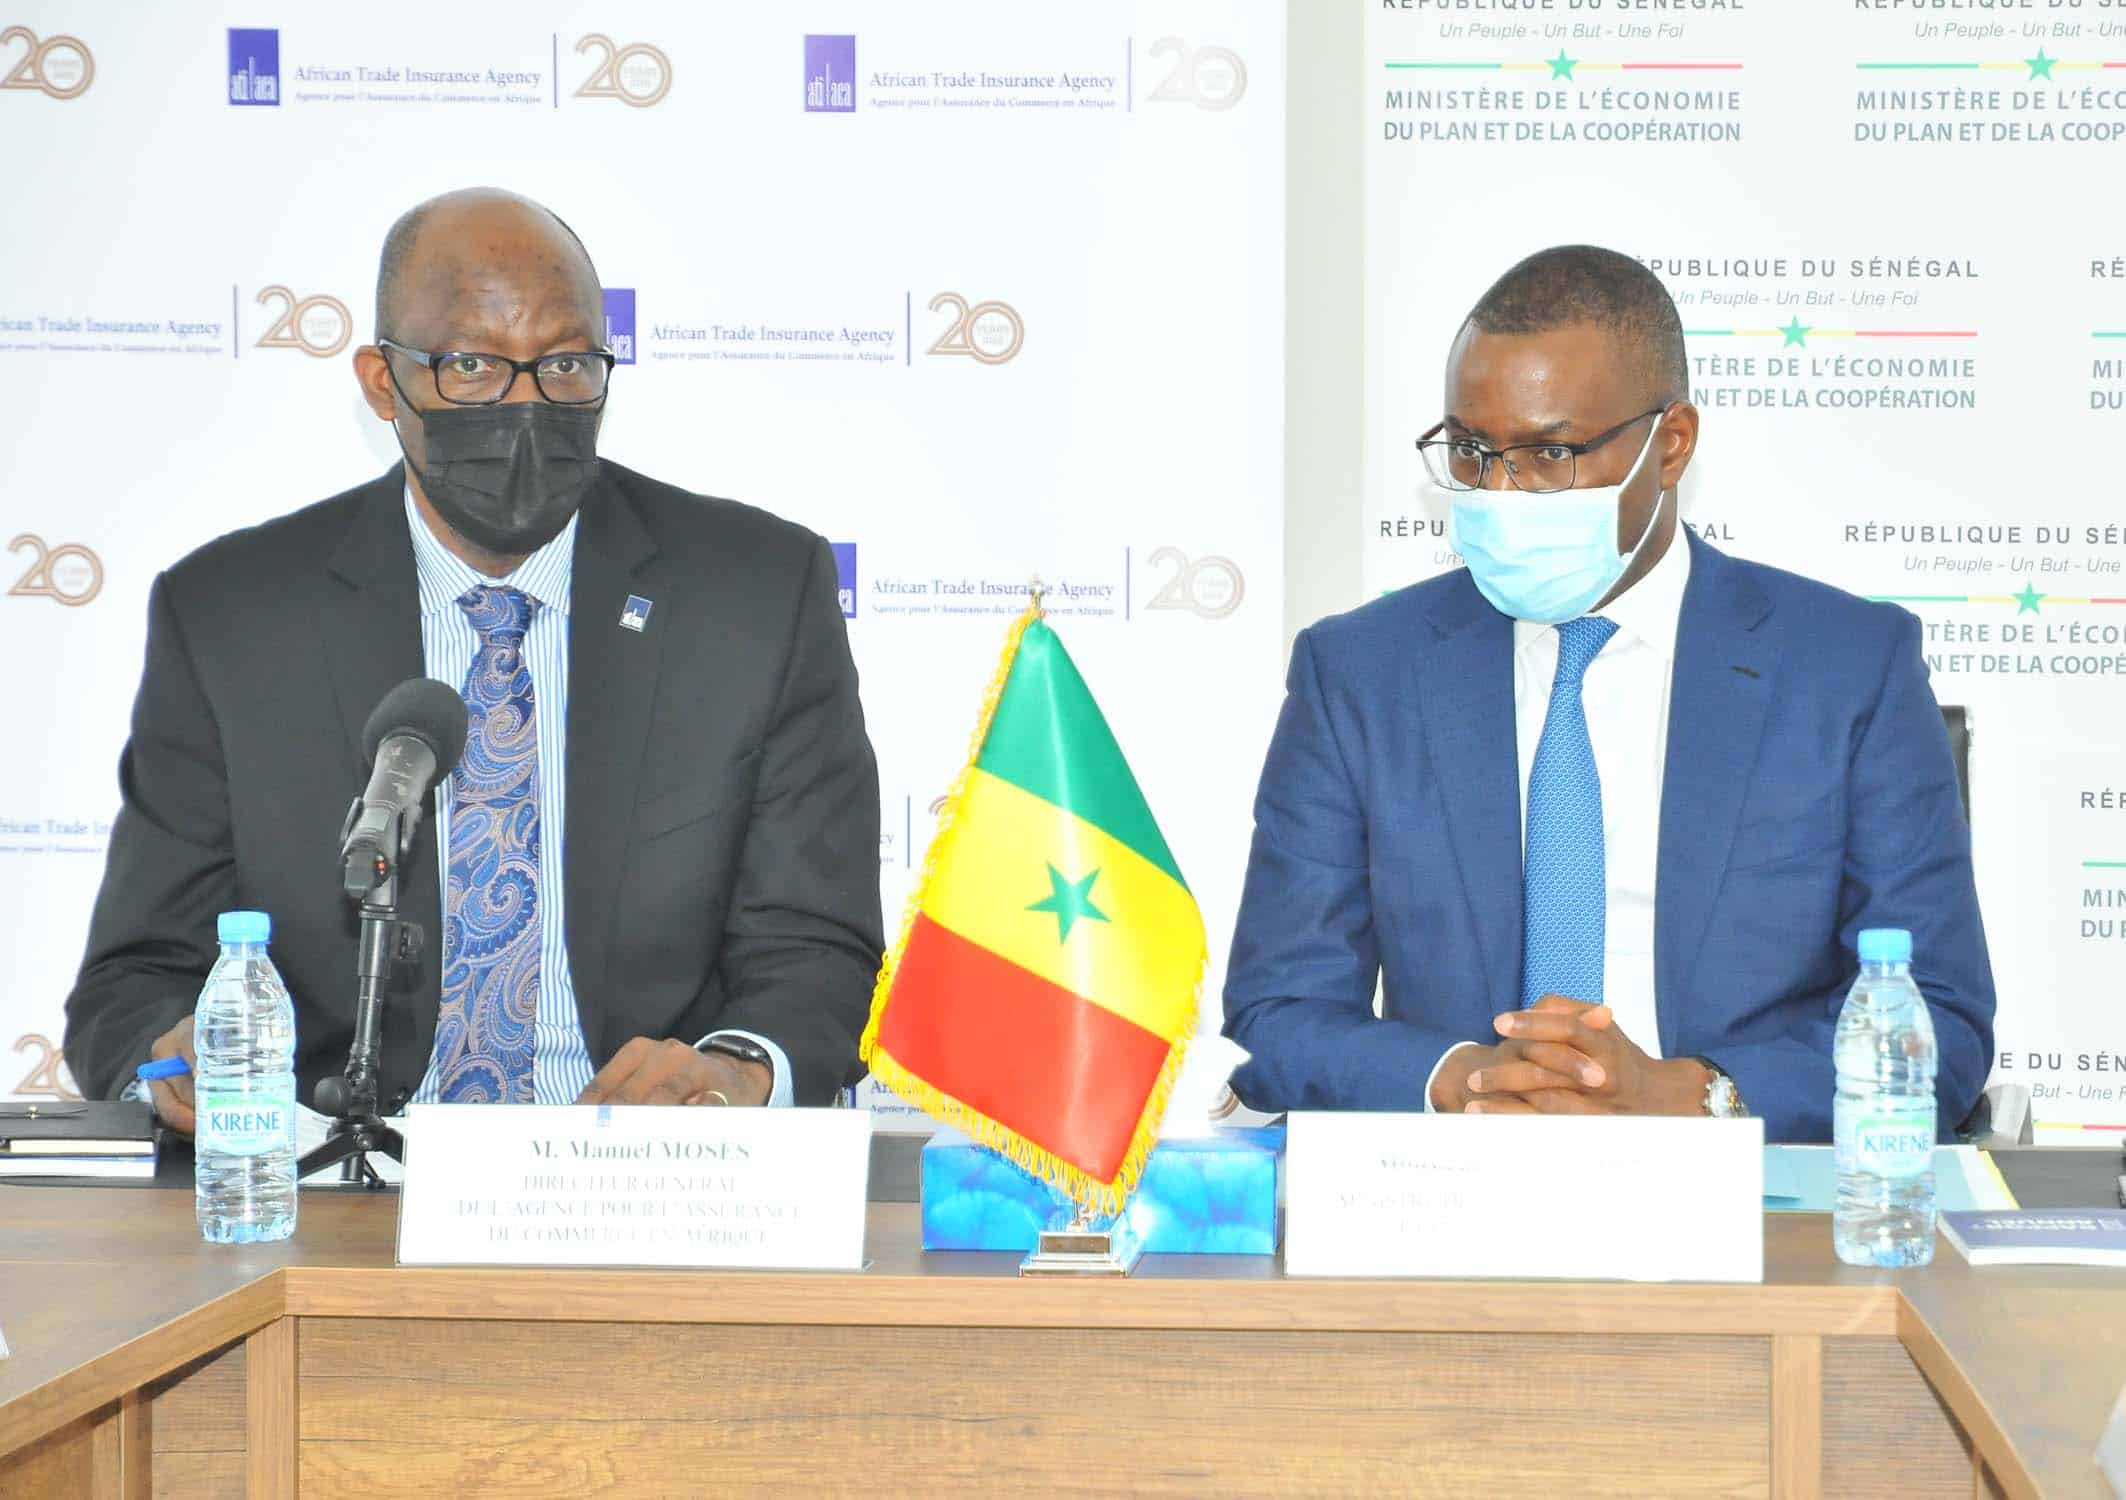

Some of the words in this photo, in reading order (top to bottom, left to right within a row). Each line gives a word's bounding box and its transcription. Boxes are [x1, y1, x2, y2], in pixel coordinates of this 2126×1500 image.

[1440, 23, 1462, 38] Un
[1468, 23, 1526, 40] Peuple
[1544, 23, 1567, 38] Un
[1573, 23, 1601, 38] But
[1618, 23, 1652, 38] Une
[1658, 23, 1686, 38] Foi
[1914, 22, 1938, 38] Un
[1944, 22, 2004, 40] Peuple
[2022, 22, 2047, 37] Un
[2052, 22, 2081, 37] But
[296, 65, 352, 81] African
[355, 66, 401, 82] Trade
[405, 66, 480, 82] Insurance
[485, 67, 542, 88] Agency
[574, 33, 672, 108] 20
[1145, 37, 1248, 112] 20
[870, 72, 927, 88] African
[930, 72, 976, 88] Trade
[980, 72, 1055, 88] Insurance
[1061, 72, 1114, 92] Agency
[1385, 88, 1524, 110] MINISTÈRE
[1535, 91, 1568, 110] DE
[1579, 88, 1740, 110] L'ÉCONOMIE
[1857, 87, 2000, 110] MINISTÈRE
[2012, 91, 2046, 110] DE
[1384, 122, 1413, 141] DU
[1420, 122, 1477, 141] PLAN
[1484, 122, 1510, 141] ET
[1515, 122, 1544, 141] DE
[1550, 122, 1577, 141] LA
[1583, 118, 1740, 141] COOPÉRATION
[1855, 122, 1886, 141] DU
[1894, 122, 1952, 141] PLAN
[1959, 122, 1985, 141] ET
[1992, 122, 2021, 141] DE
[2027, 122, 2055, 141] LA
[2062, 122, 2126, 141] COOP
[1642, 257, 1787, 277] PUBLIQUE
[1801, 259, 1835, 277] DU
[1850, 256, 1978, 278] SÉNÉGAL
[1700, 290, 1758, 308] Peuple
[1776, 290, 1800, 305] Un
[1806, 290, 1834, 305] But
[1852, 290, 1886, 306] Une
[1891, 290, 1920, 305] Foi
[255, 285, 353, 359] 20
[926, 291, 1024, 365] 20
[650, 325, 706, 341] African
[711, 325, 754, 341] Trade
[760, 326, 835, 342] Insurance
[840, 327, 895, 346] Agency
[1768, 358, 1800, 376] DE
[1812, 355, 1975, 377] L'ÉCONOMIE
[1716, 389, 1742, 407] ET
[1747, 389, 1776, 407] DE
[1782, 389, 1809, 407] LA
[1815, 385, 1976, 408] COOPÉRATION
[2090, 391, 2123, 410] DU
[1845, 520, 2021, 544] RÉPUBLIQUE
[2036, 526, 2070, 544] DU
[8, 533, 104, 607] 20
[1904, 556, 1928, 571] Un
[1934, 556, 1993, 575] Peuple
[2011, 557, 2034, 572] Un
[2040, 558, 2069, 572] But
[2088, 558, 2121, 573] Une
[873, 579, 928, 594] African
[931, 579, 975, 594] Trade
[981, 579, 1054, 595] Insurae
[1060, 581, 1114, 601] Agency
[1145, 546, 1245, 619] 20
[2002, 625, 2034, 643] DE
[2047, 621, 2126, 644] L'ÉCO
[1949, 655, 1975, 673] ET
[1981, 655, 2010, 673] DE
[2017, 655, 2044, 674] LA
[2081, 919, 2113, 939] DU
[2028, 1052, 2061, 1070] DU
[2032, 1083, 2061, 1099] But
[2079, 1084, 2113, 1100] Une
[530, 1140, 559, 1159] M.
[569, 1139, 651, 1160] Manuel
[660, 1140, 751, 1161] MOSES
